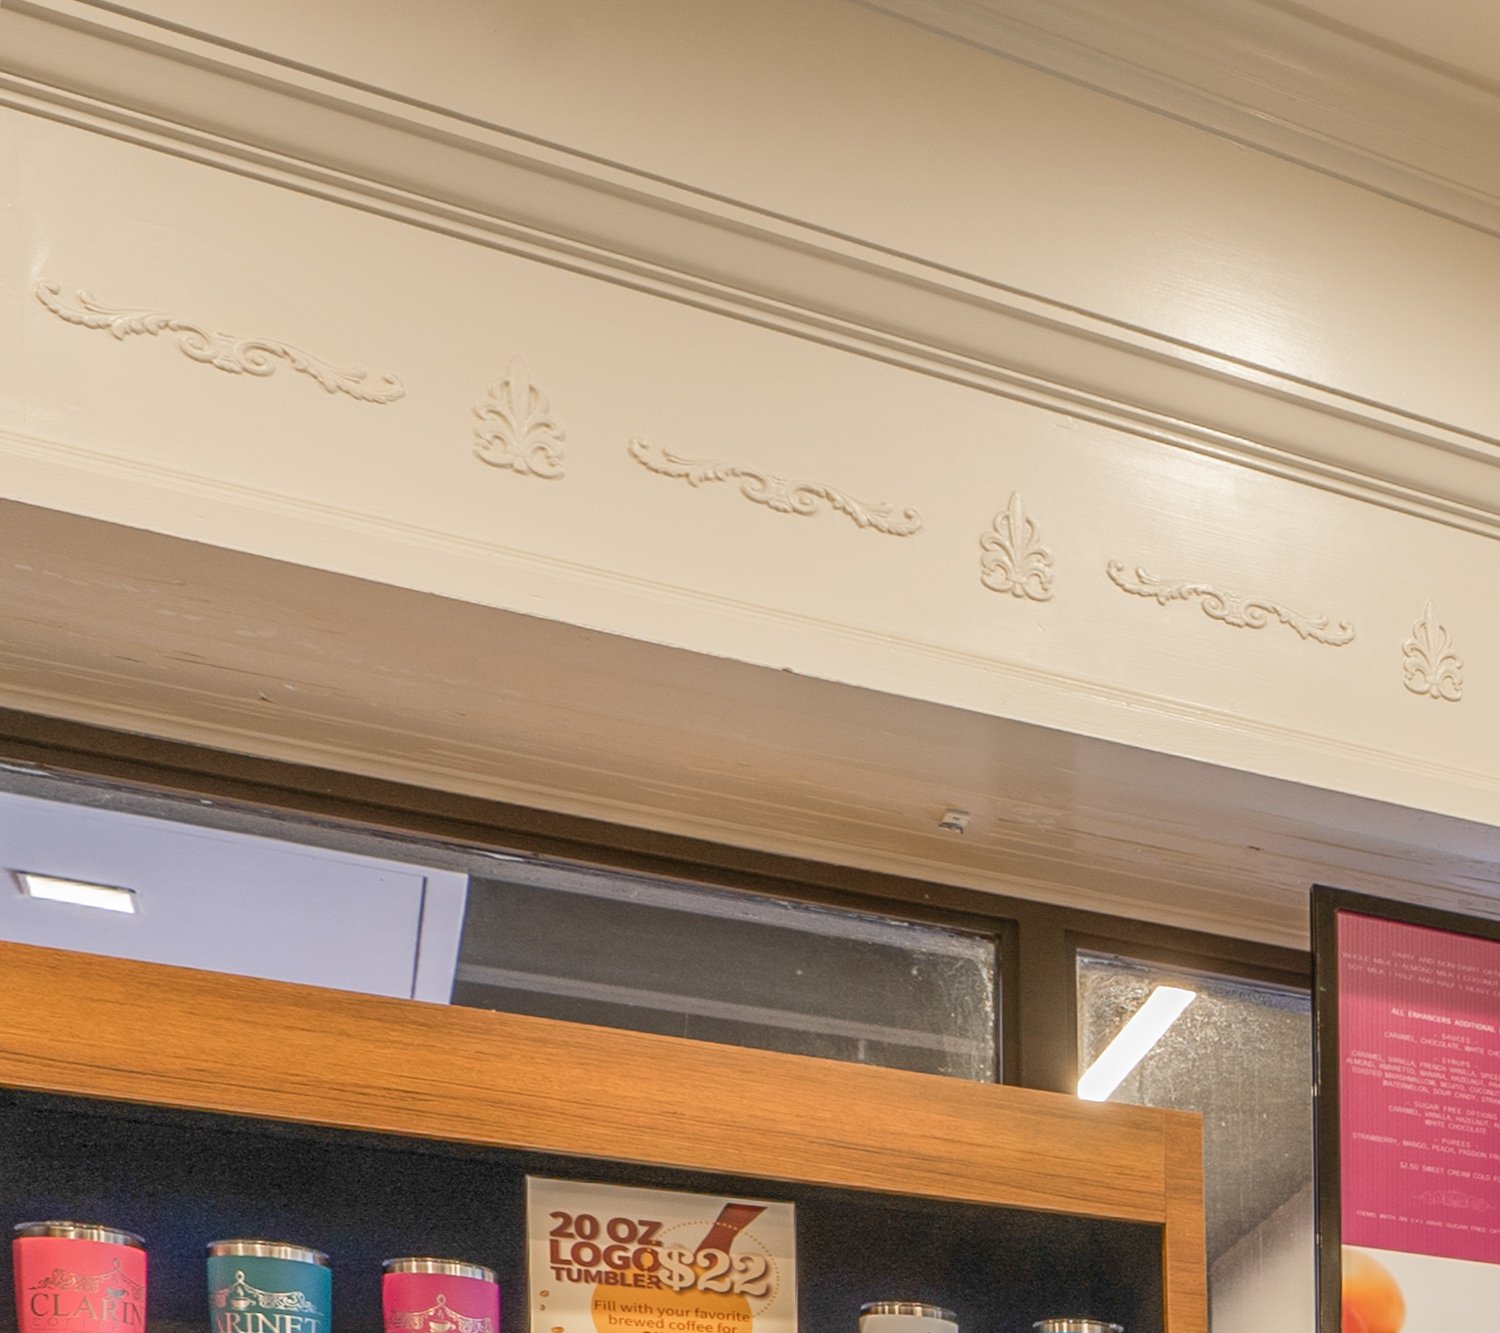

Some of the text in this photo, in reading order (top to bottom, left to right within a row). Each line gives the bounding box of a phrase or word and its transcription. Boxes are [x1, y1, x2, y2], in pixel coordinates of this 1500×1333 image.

[550, 1211, 663, 1247] 20 OZ
[550, 1239, 662, 1273] LOGO
[658, 1244, 769, 1296] $22
[550, 1266, 663, 1290] TUMBLER
[594, 1300, 750, 1322] Fill with your favorite
[608, 1315, 664, 1330] brewed
[669, 1318, 713, 1333] coffee
